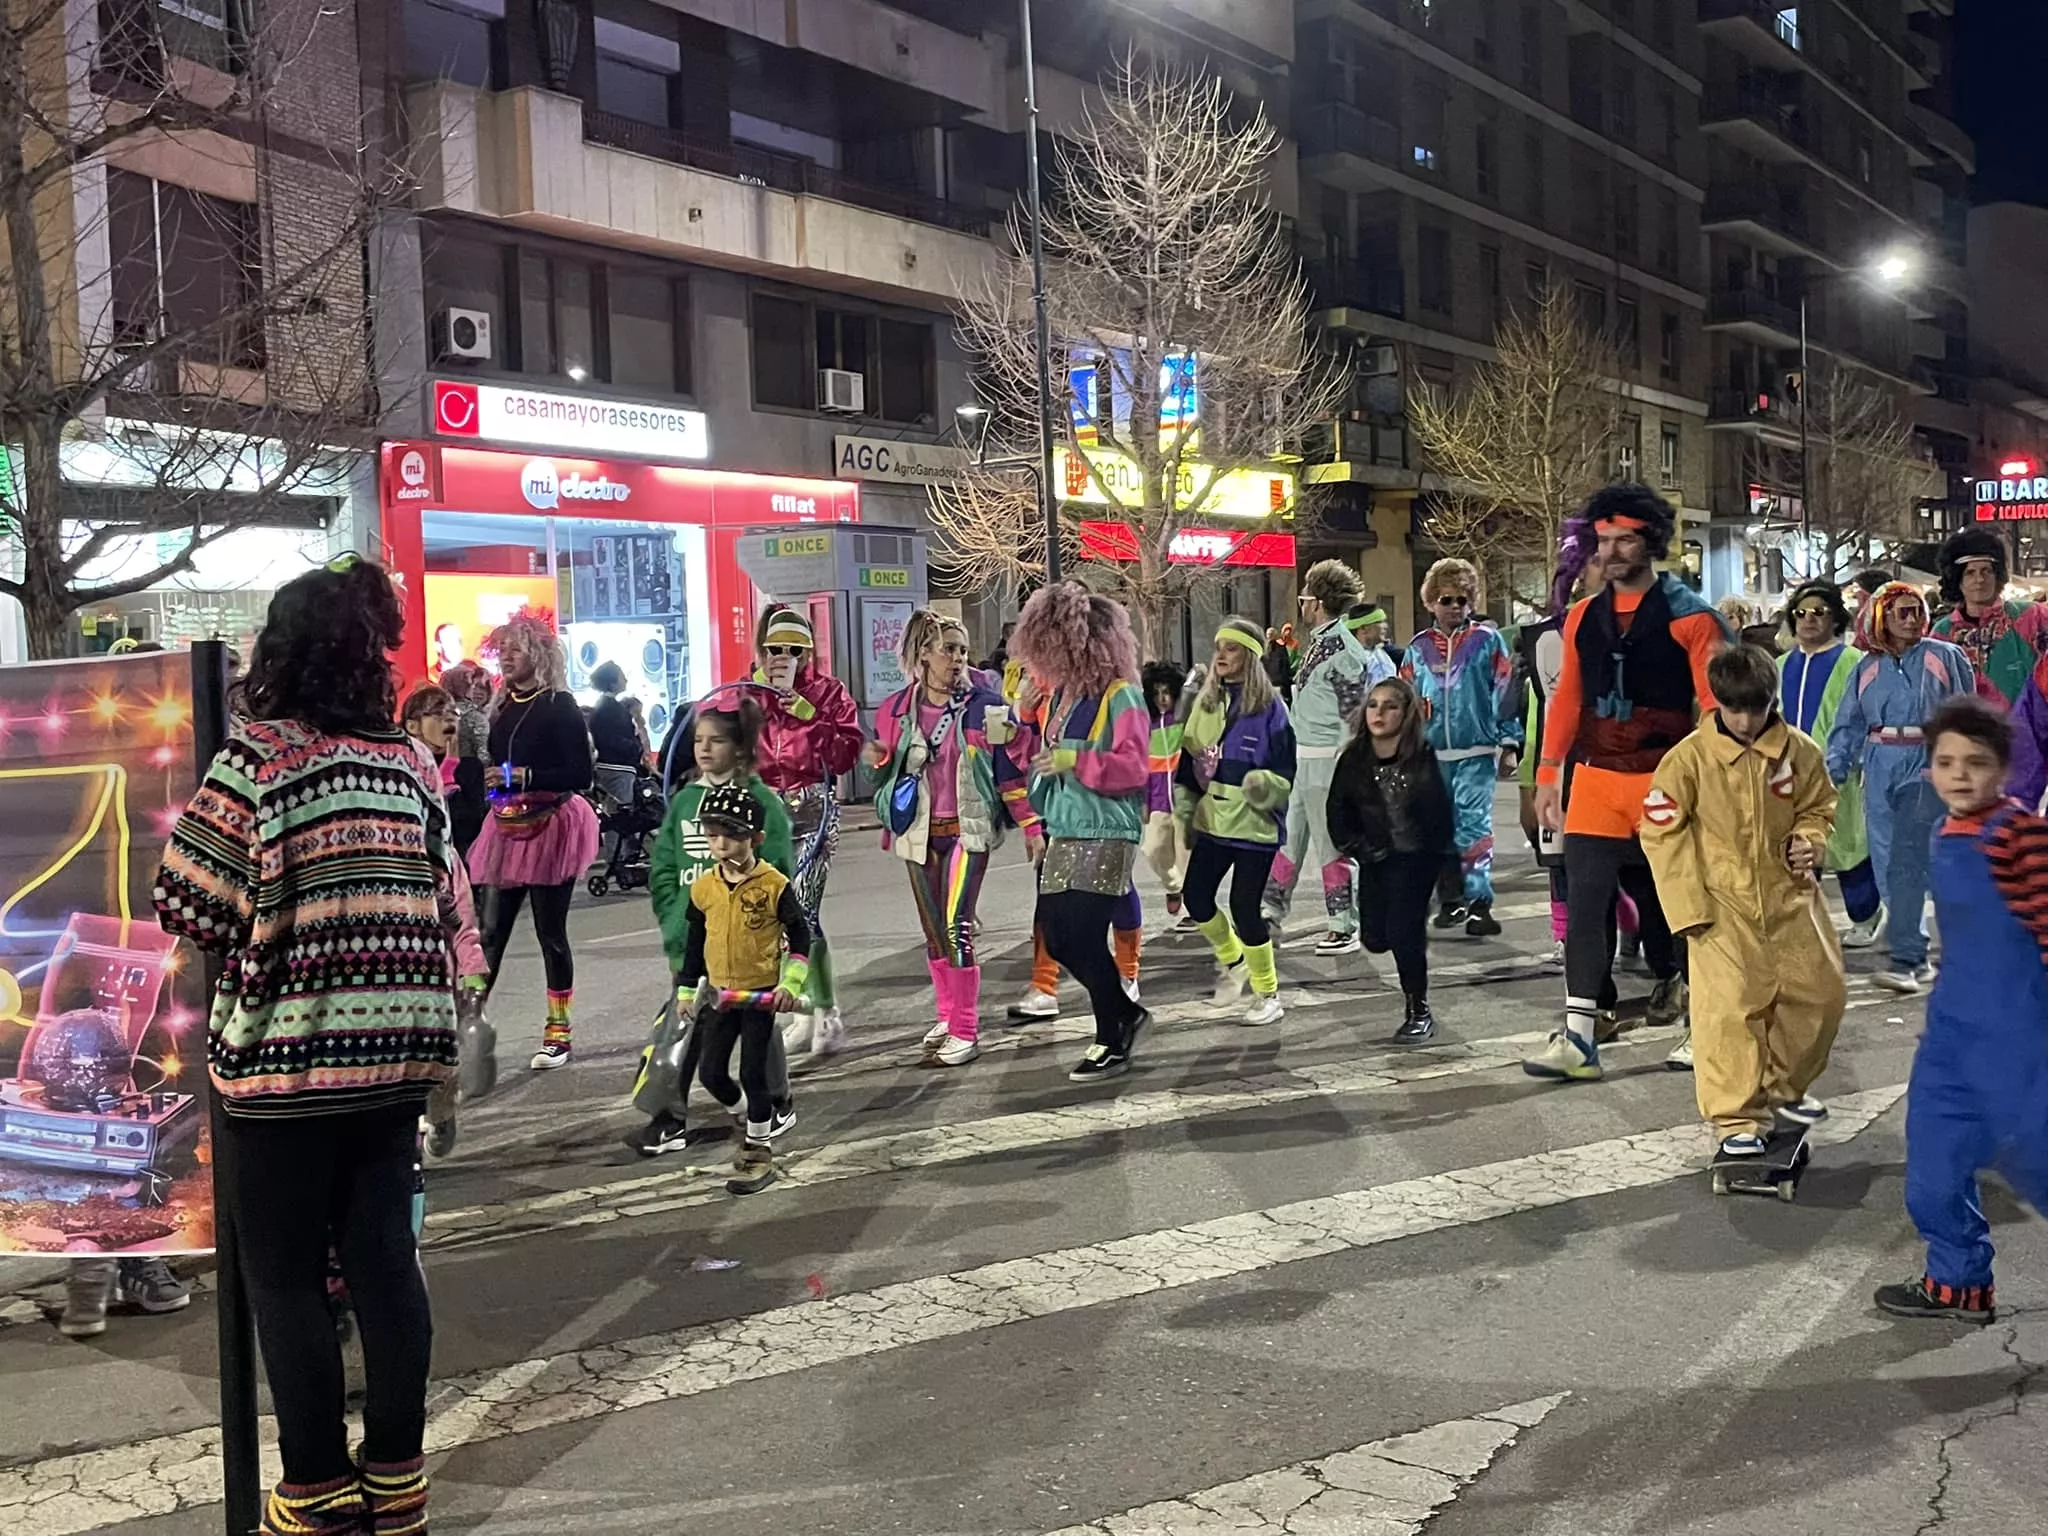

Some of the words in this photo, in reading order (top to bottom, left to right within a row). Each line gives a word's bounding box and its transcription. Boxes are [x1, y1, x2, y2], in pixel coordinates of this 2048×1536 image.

[504, 396, 687, 433] casamayorasesores
[405, 459, 421, 475] mi
[841, 443, 890, 472] AGC
[530, 475, 553, 494] mi
[2000, 477, 2048, 501] BAR
[771, 494, 816, 514] fillat
[783, 538, 825, 553] ONCE
[874, 571, 906, 585] ONCE
